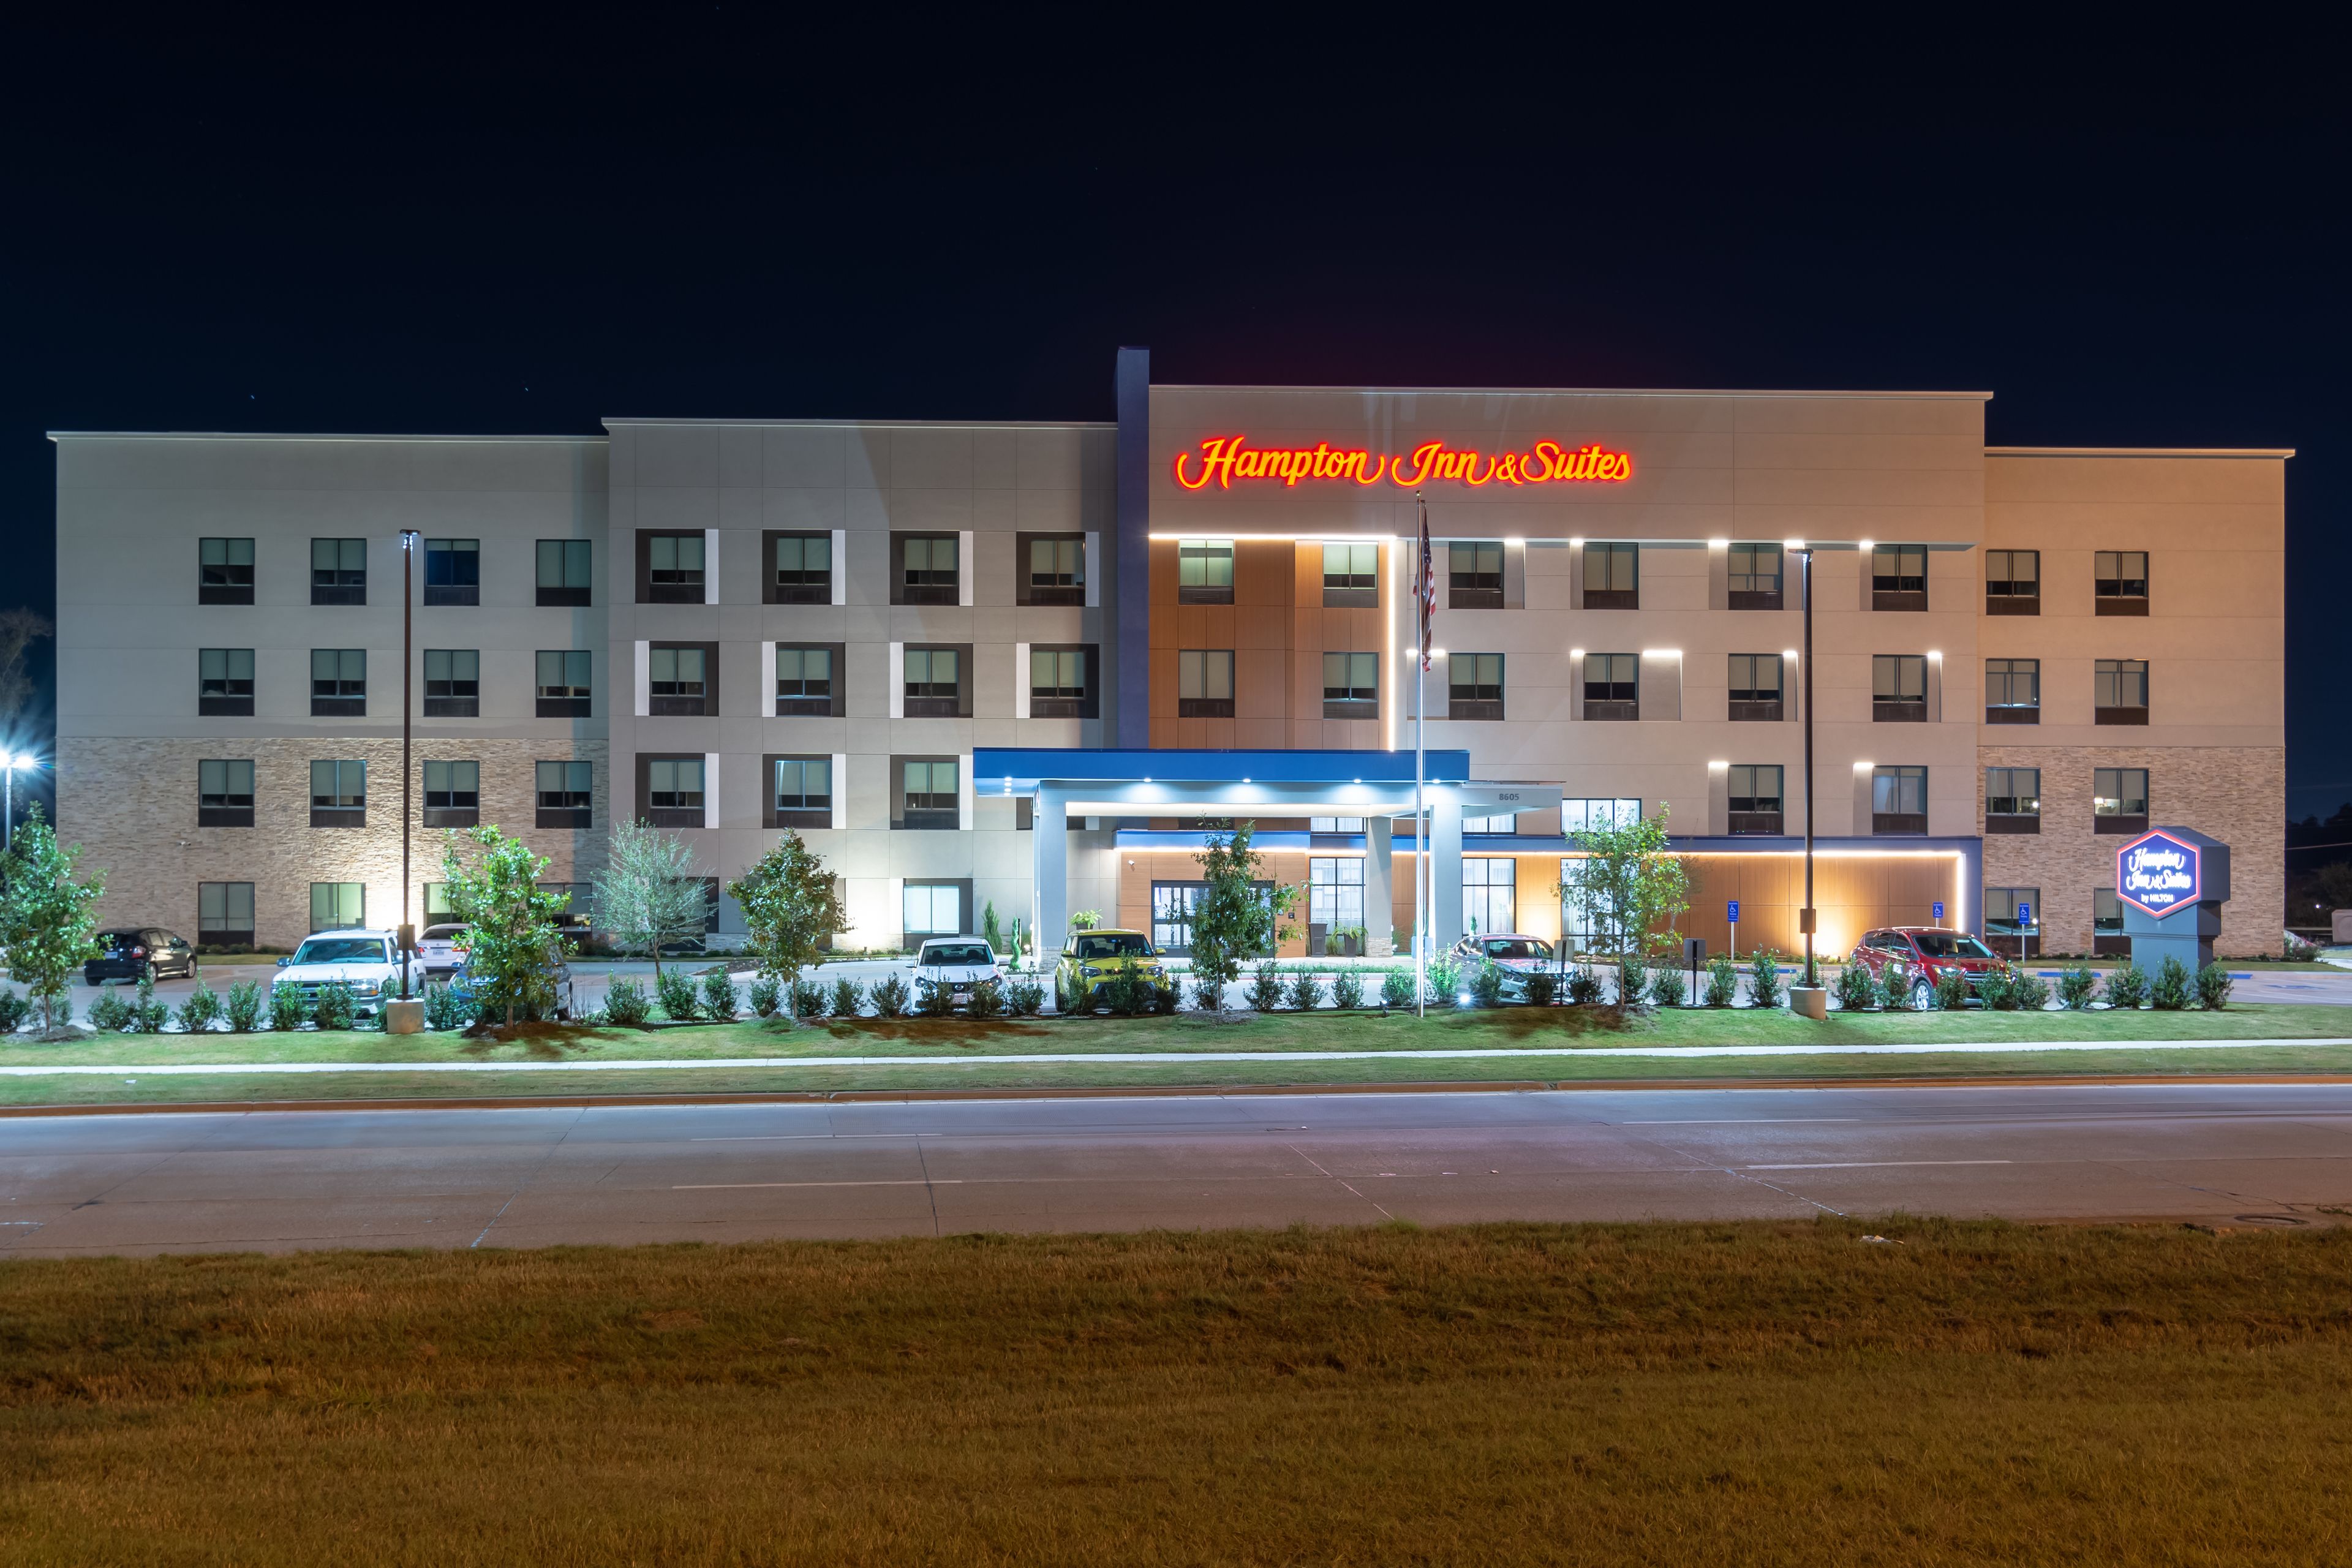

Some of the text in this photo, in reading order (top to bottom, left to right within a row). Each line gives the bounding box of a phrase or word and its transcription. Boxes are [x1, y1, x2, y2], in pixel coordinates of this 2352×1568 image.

[1177, 436, 1632, 489] Hampton Inn & Suites
[2128, 847, 2185, 872] Hampton
[2141, 894, 2149, 903] by
